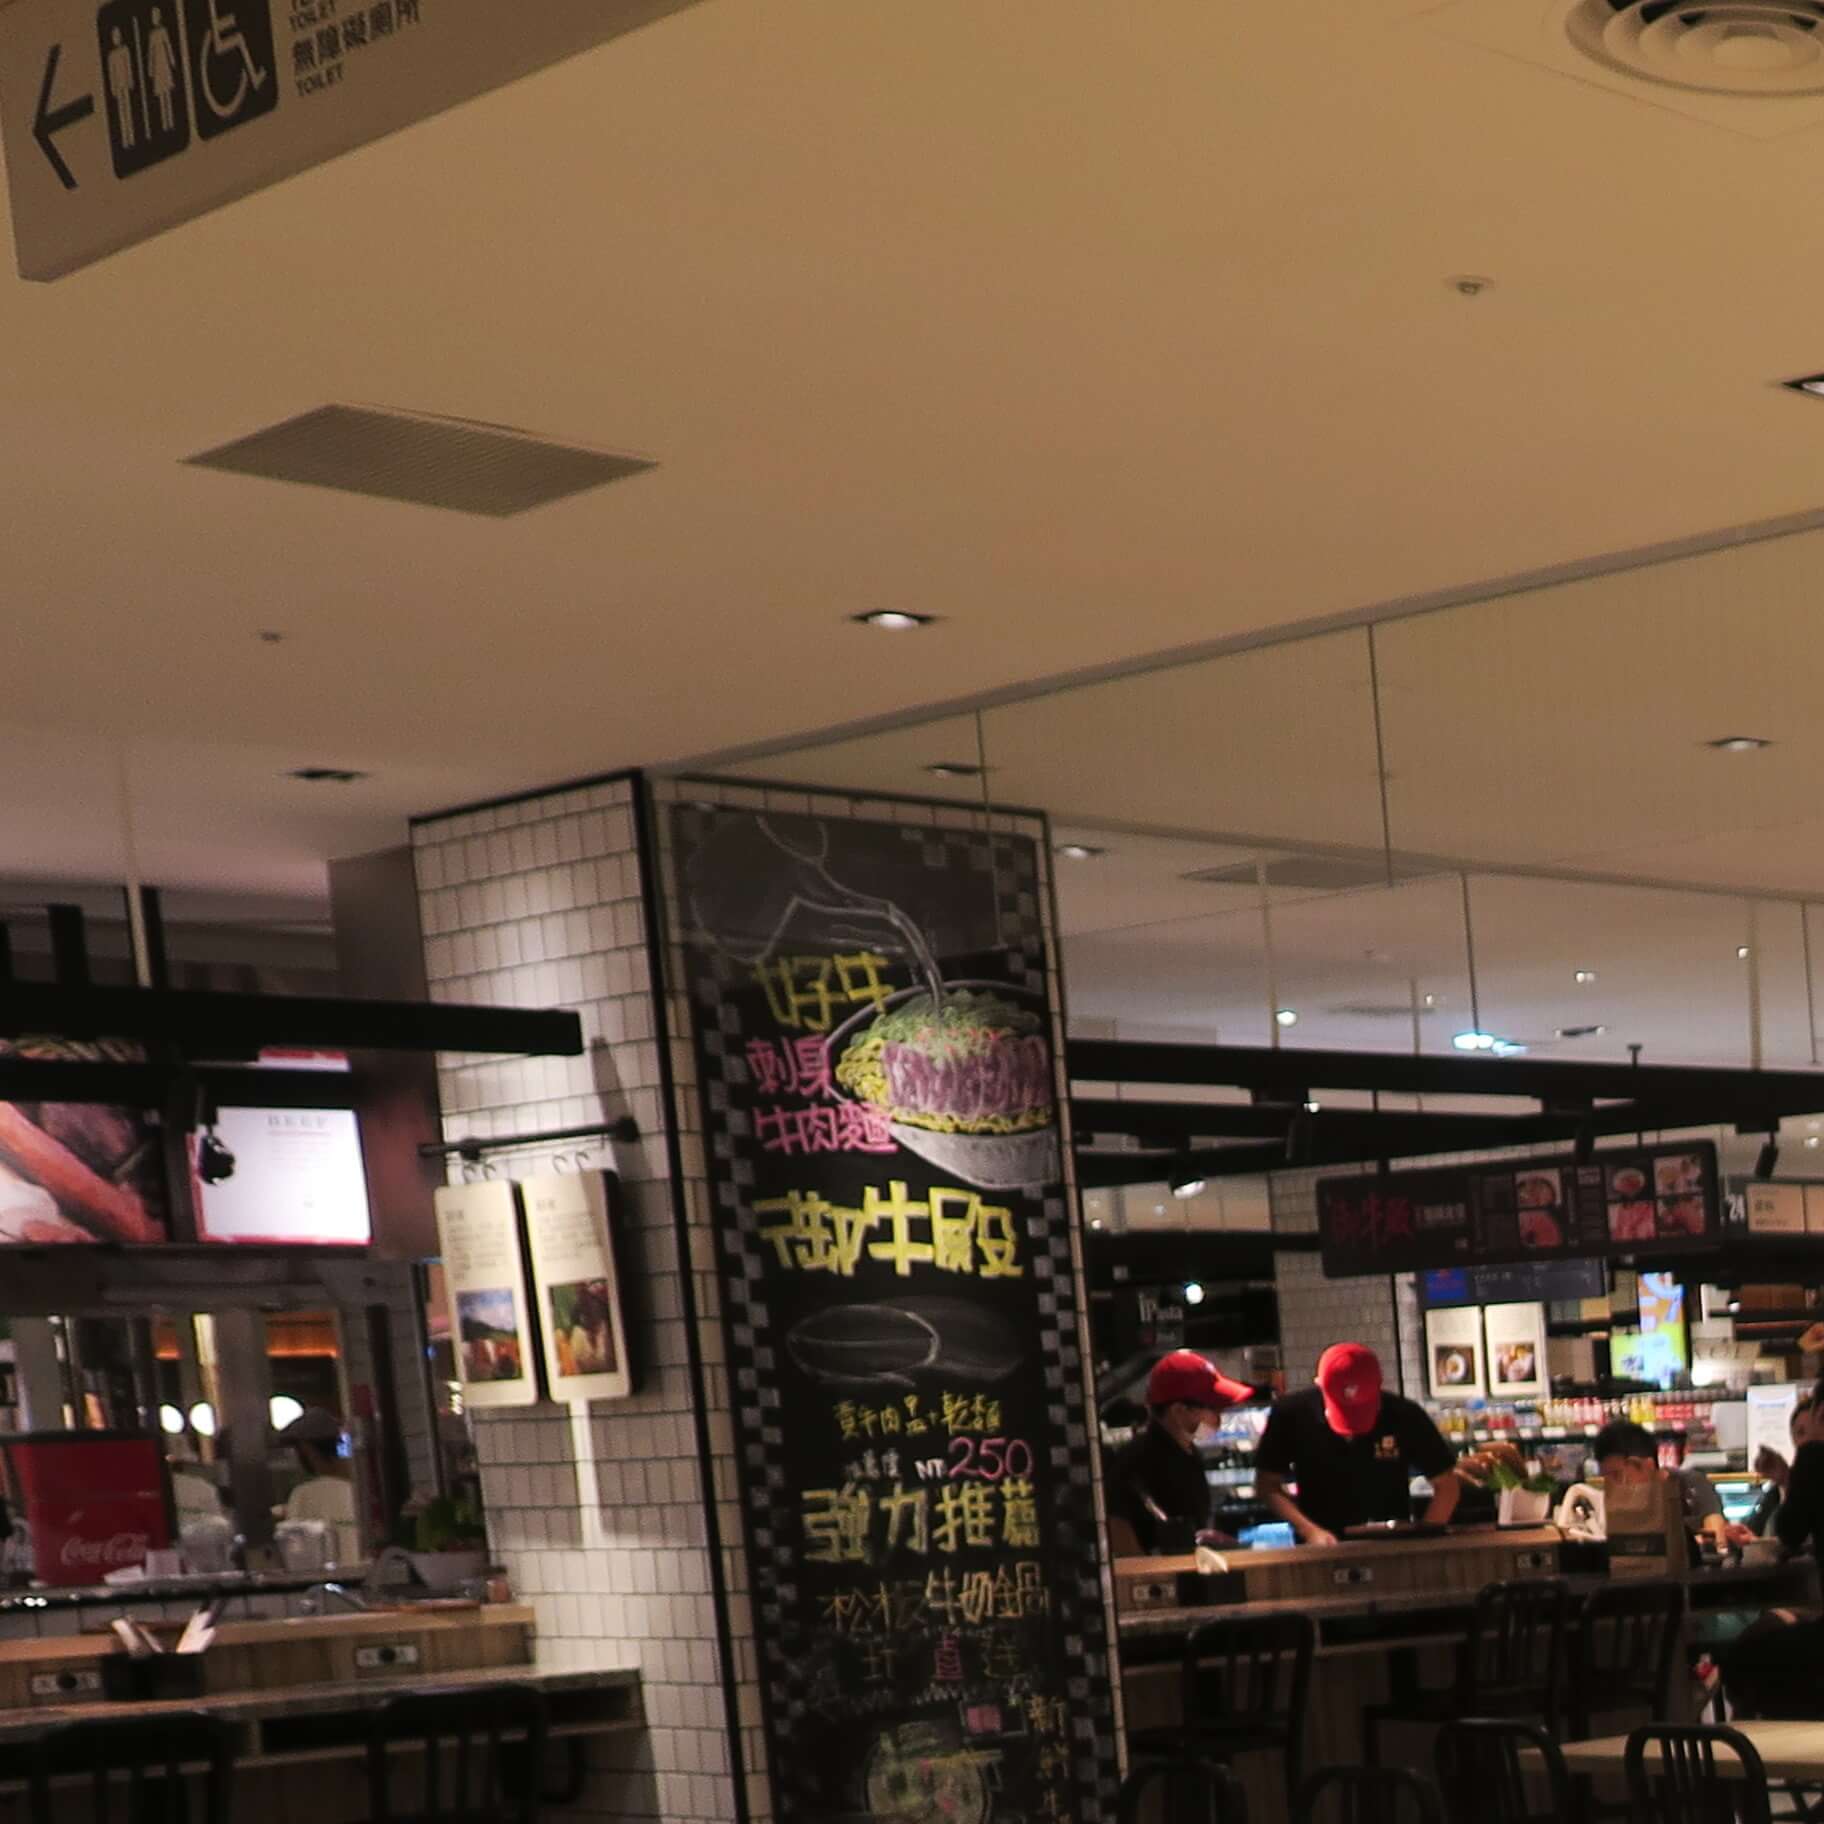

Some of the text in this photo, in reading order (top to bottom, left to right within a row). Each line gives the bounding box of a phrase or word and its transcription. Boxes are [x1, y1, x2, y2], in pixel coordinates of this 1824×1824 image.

[296, 62, 344, 96] TOILET
[752, 1100, 900, 1154] 牛肉麵
[752, 1180, 1024, 1278] 御牛殿
[1728, 1194, 1746, 1222] 24
[948, 1435, 1034, 1481] 250
[801, 1480, 1041, 1564] 強力推薦
